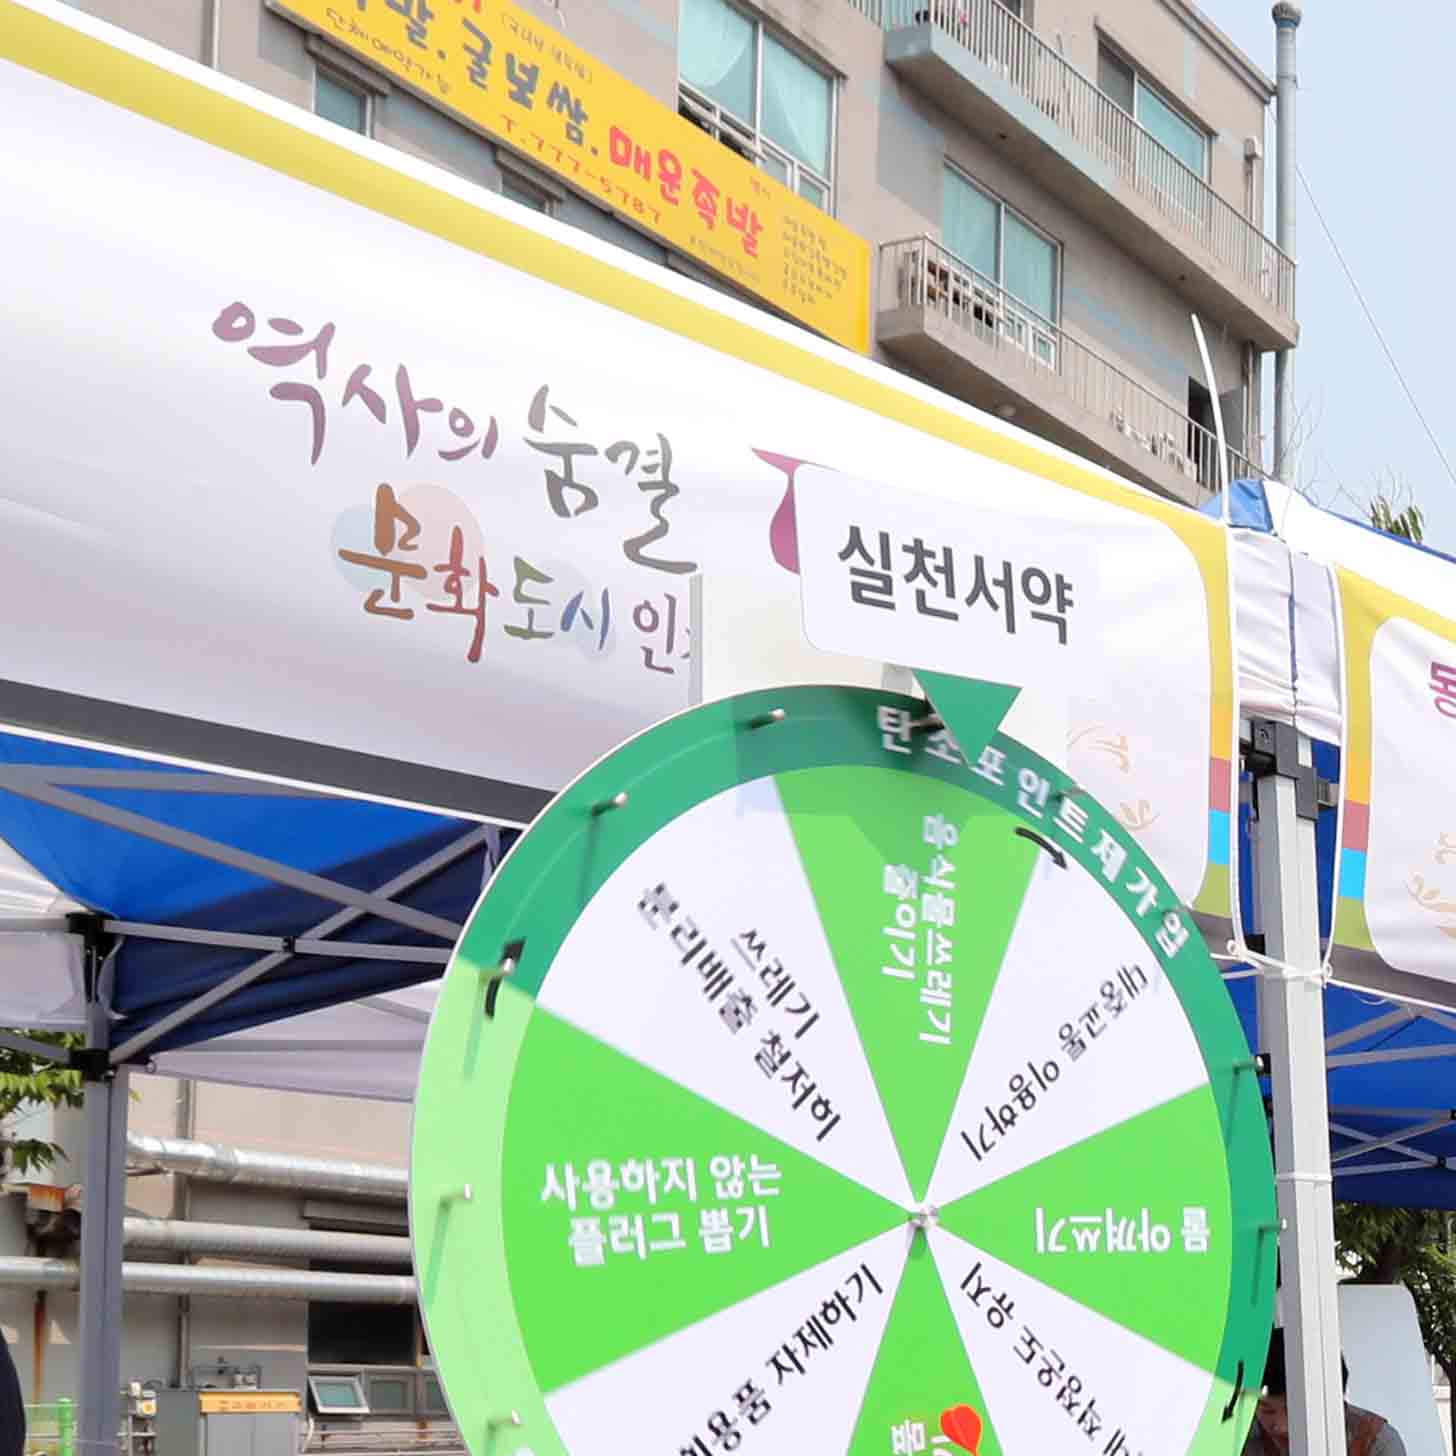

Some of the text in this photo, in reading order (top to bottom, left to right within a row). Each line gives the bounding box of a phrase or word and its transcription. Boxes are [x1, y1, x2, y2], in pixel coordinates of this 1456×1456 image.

[211, 301, 698, 574] 역사의 숨결
[338, 483, 692, 674] 문화도시 인
[838, 523, 1074, 644] 실천서약
[881, 862, 919, 981] 줄이기
[919, 813, 960, 1047] 음식물쓰레기
[637, 882, 843, 1143] 분리배출 철저히
[737, 926, 821, 1039] 쓰레기
[964, 963, 1151, 1162] 대중교통 이용하기
[539, 1152, 783, 1206] 사용하지 않는
[568, 1205, 771, 1265] 플러그 뽑기
[1035, 1206, 1213, 1256] 물 아껴쓰기
[764, 1261, 886, 1388] 자제하기
[958, 1261, 1017, 1330] 유지
[1015, 1331, 1103, 1442] 적정온도
